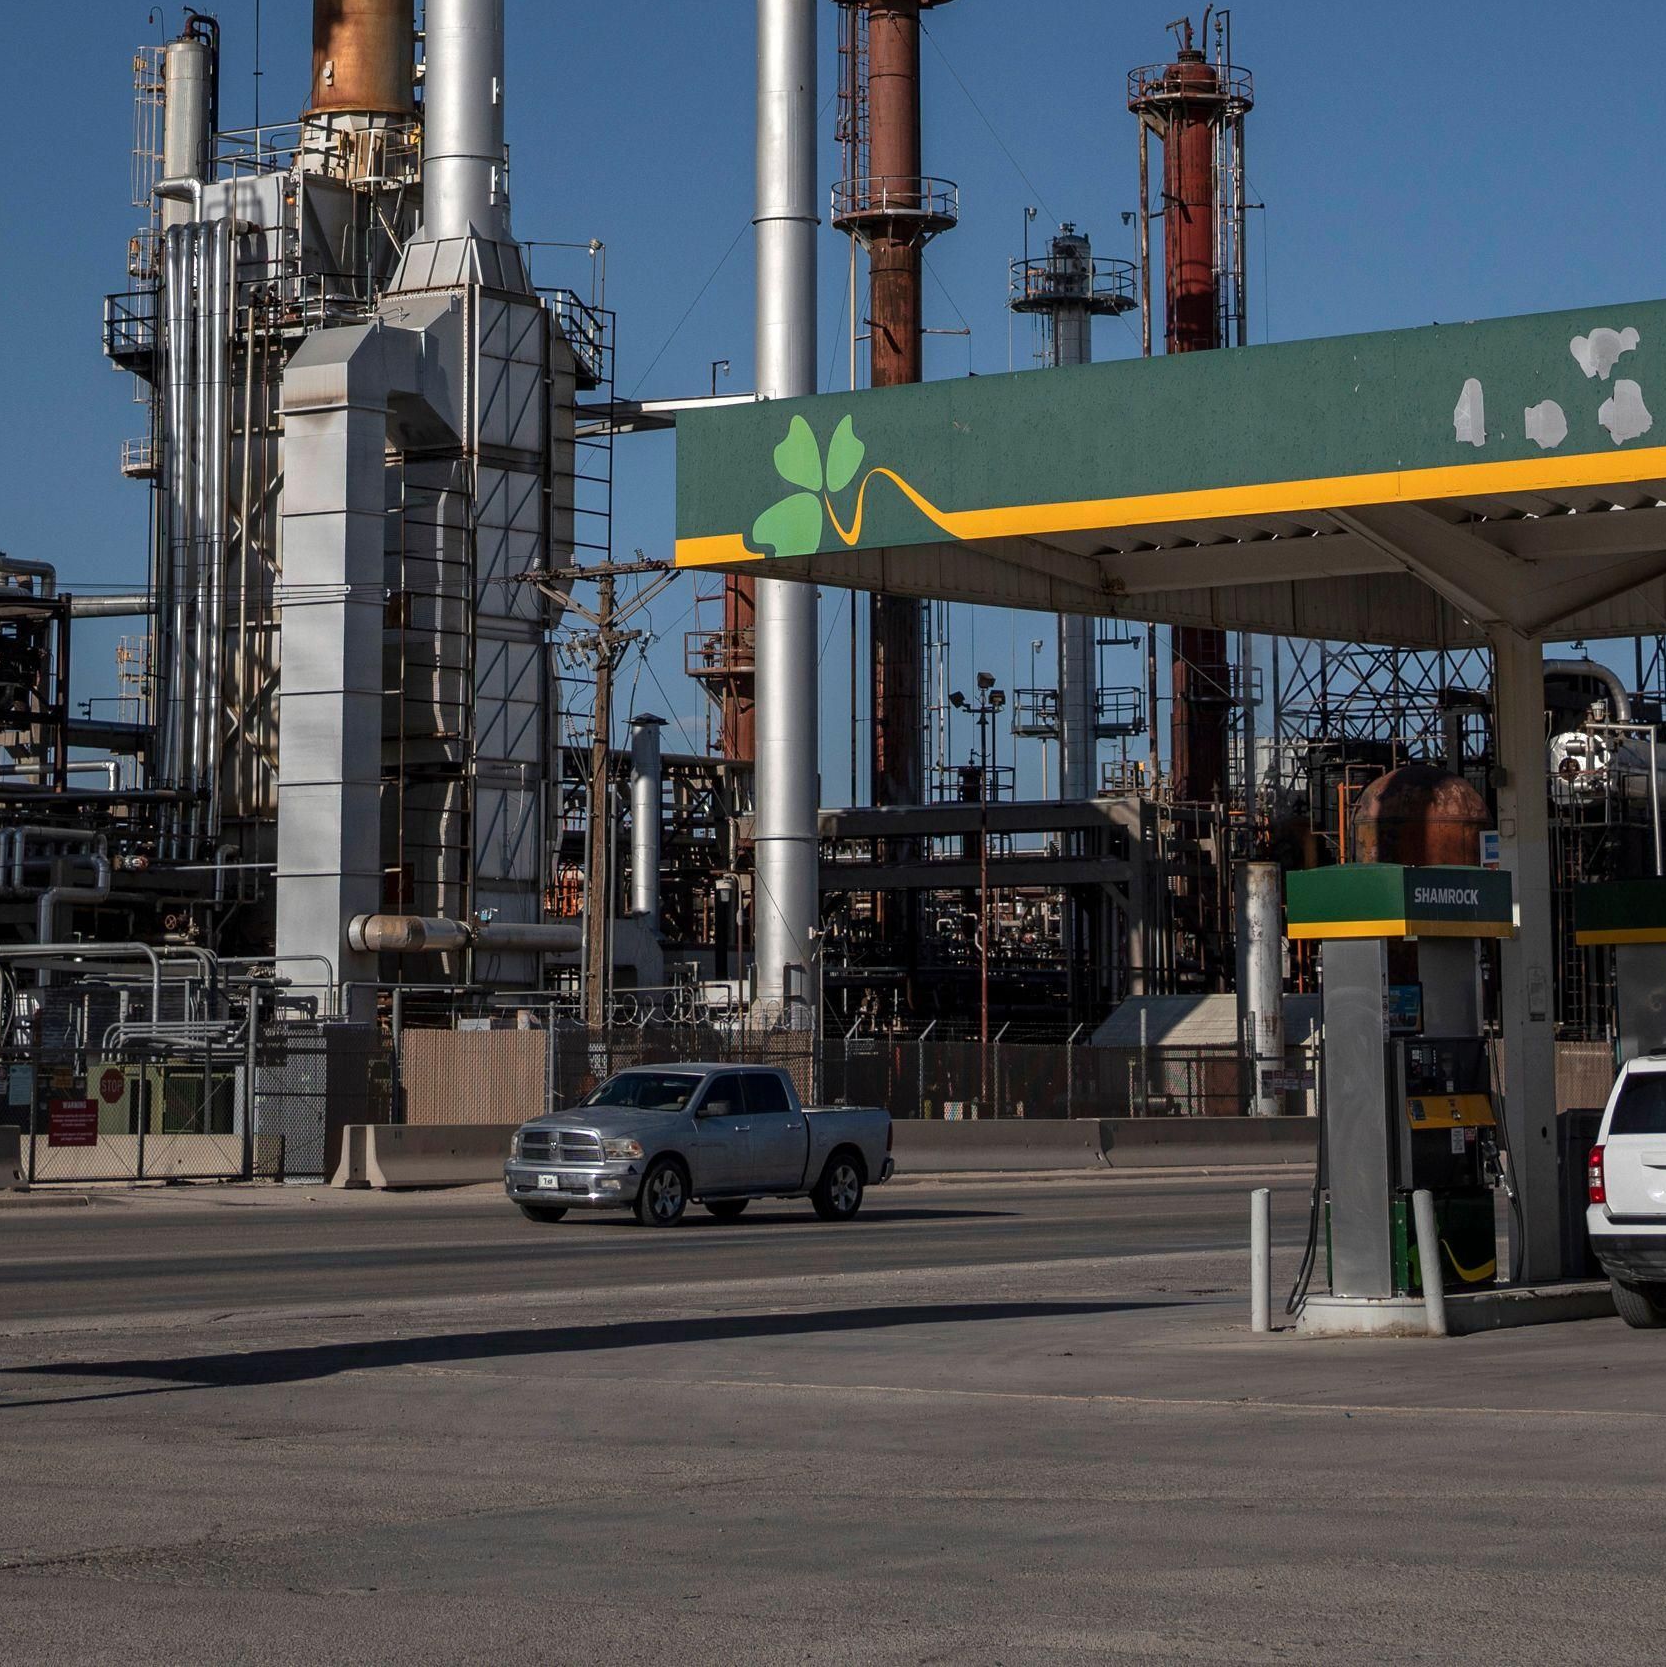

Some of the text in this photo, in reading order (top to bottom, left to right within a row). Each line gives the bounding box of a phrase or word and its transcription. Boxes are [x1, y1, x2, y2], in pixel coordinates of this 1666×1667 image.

[1414, 887, 1479, 906] SHAMROCK
[101, 1079, 123, 1093] STOP
[62, 1101, 87, 1109] WARNING
